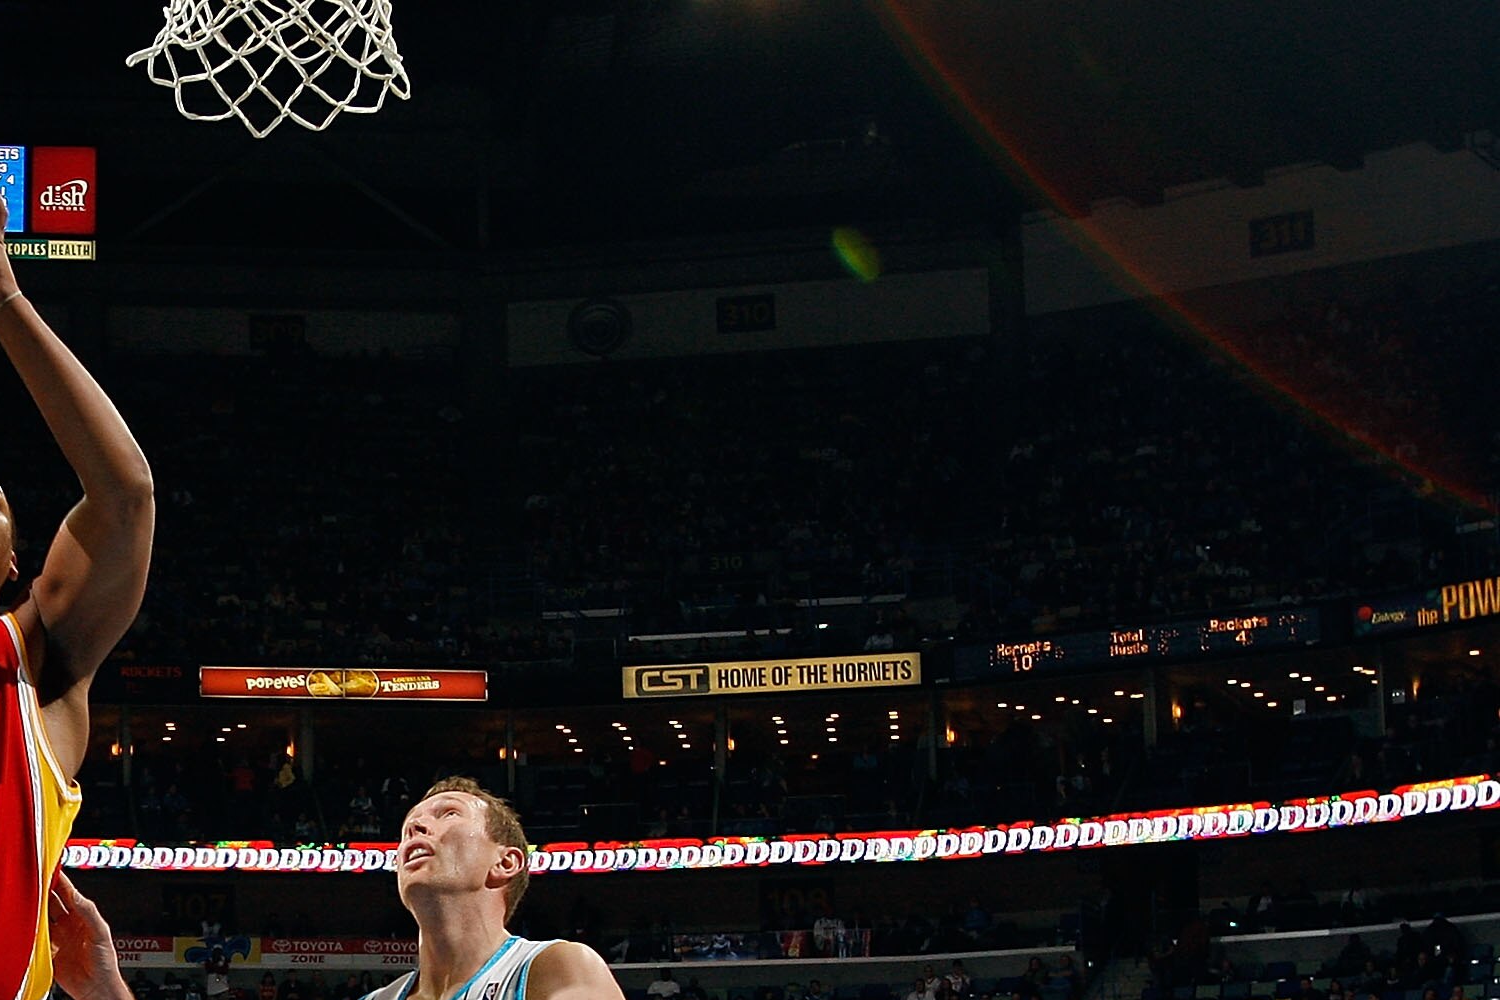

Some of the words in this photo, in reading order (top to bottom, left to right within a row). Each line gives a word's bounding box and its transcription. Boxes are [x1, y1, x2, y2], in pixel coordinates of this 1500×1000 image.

[40, 180, 88, 206] dish
[51, 246, 90, 258] HEALTH
[1417, 607, 1438, 627] the
[1110, 628, 1143, 643] Total
[996, 640, 1051, 657] Hornets
[1012, 655, 1033, 672] 10
[641, 669, 705, 691] CST
[718, 667, 767, 689] HOME
[772, 665, 793, 686] OF
[796, 663, 828, 685] THE
[833, 660, 912, 684] HORNETS
[381, 679, 440, 693] TENDERS
[113, 939, 160, 951] OYOTA
[292, 940, 343, 953] TOYOTA
[384, 941, 417, 953] TOYO
[291, 955, 326, 964] ZONE
